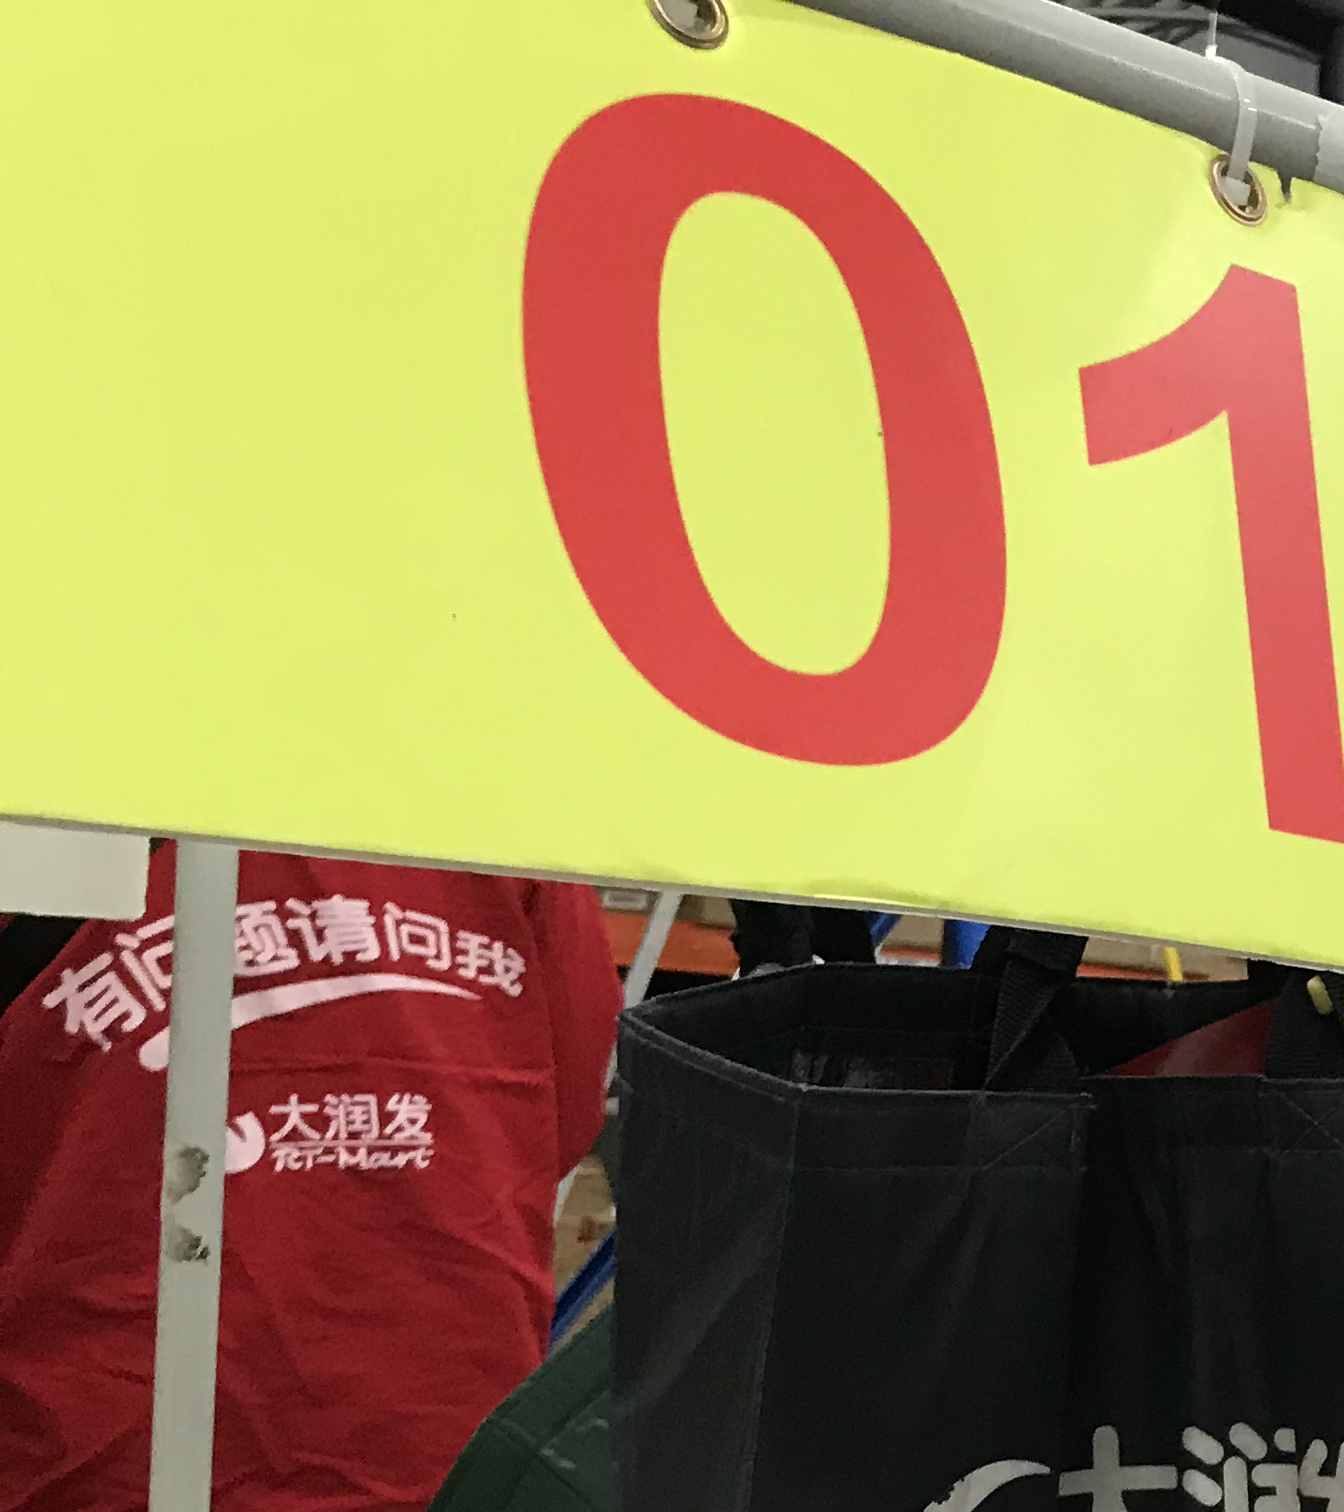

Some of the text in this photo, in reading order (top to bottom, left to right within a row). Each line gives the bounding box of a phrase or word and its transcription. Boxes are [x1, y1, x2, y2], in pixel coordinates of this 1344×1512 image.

[268, 1091, 435, 1142] 大润发
[270, 1147, 436, 1173] RT-Mart
